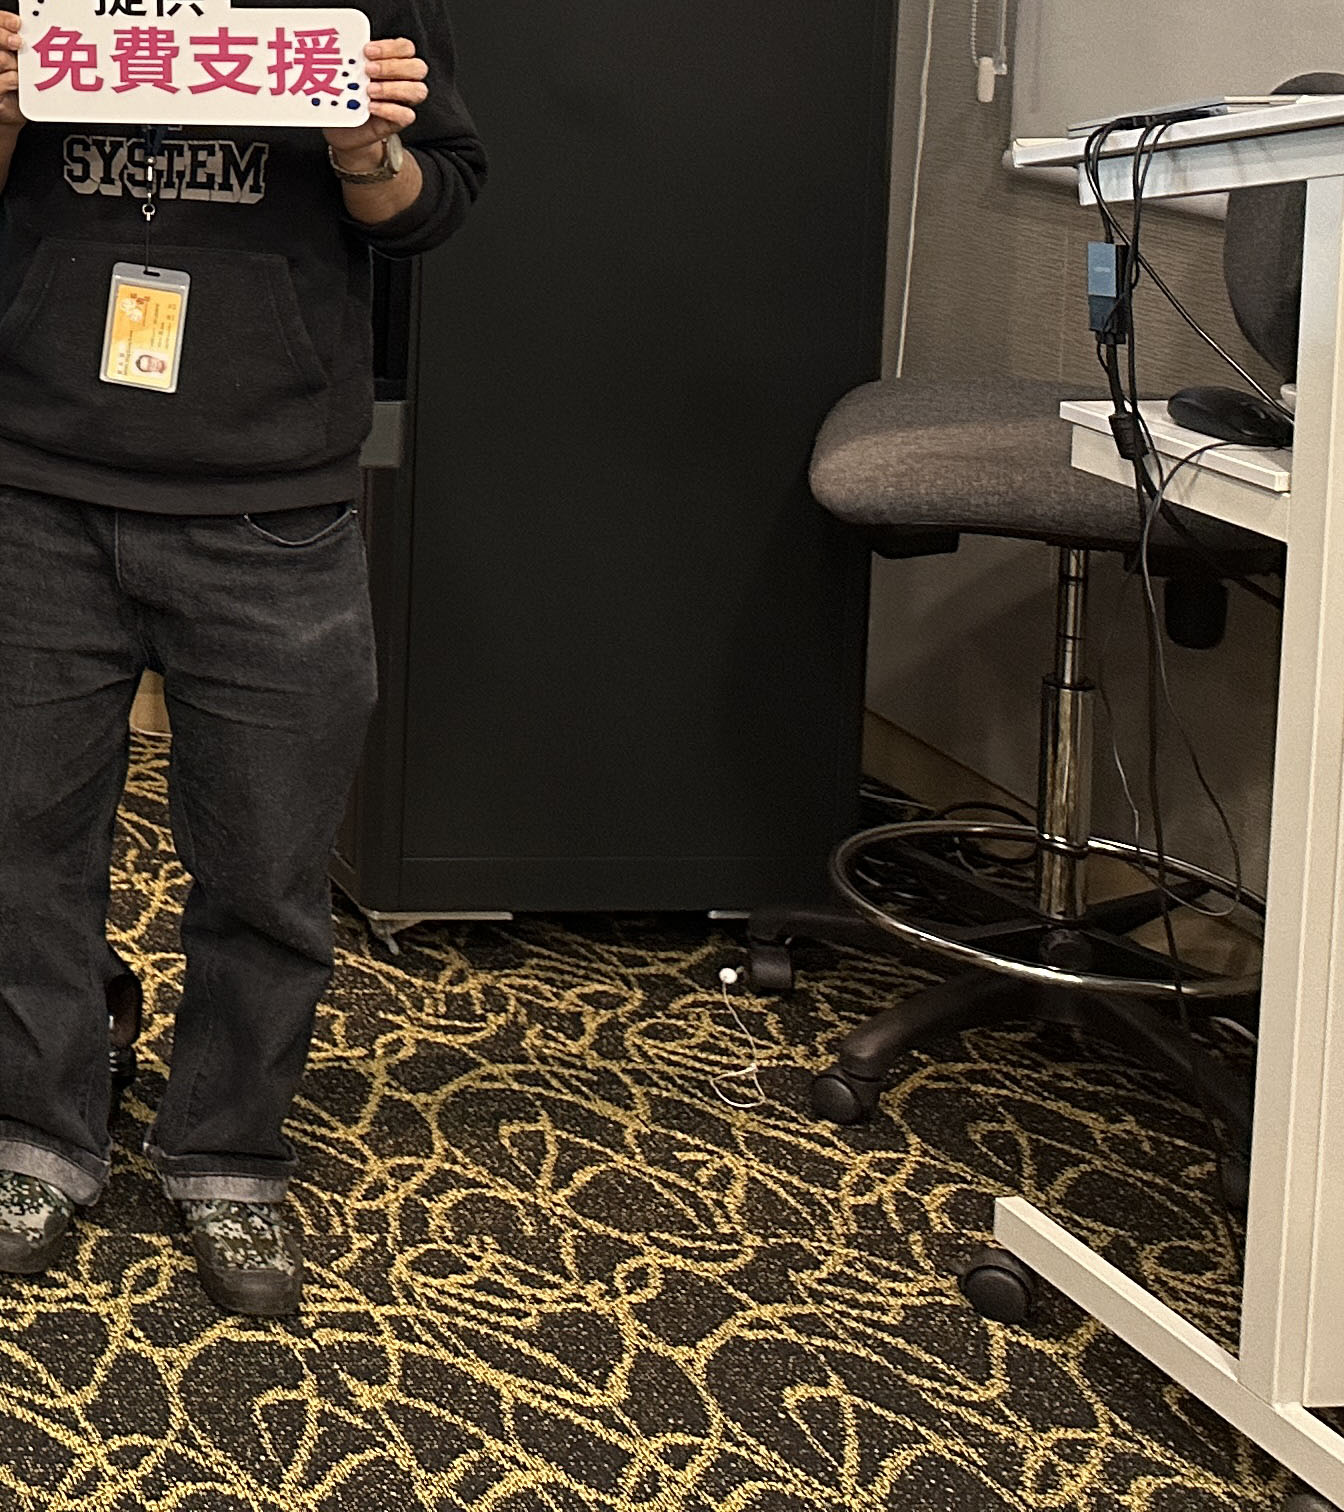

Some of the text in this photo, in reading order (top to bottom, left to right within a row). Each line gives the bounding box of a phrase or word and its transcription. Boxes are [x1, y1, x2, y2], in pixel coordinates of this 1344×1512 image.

[32, 25, 345, 97] 免費支援
[63, 134, 270, 204] SYSTEM
